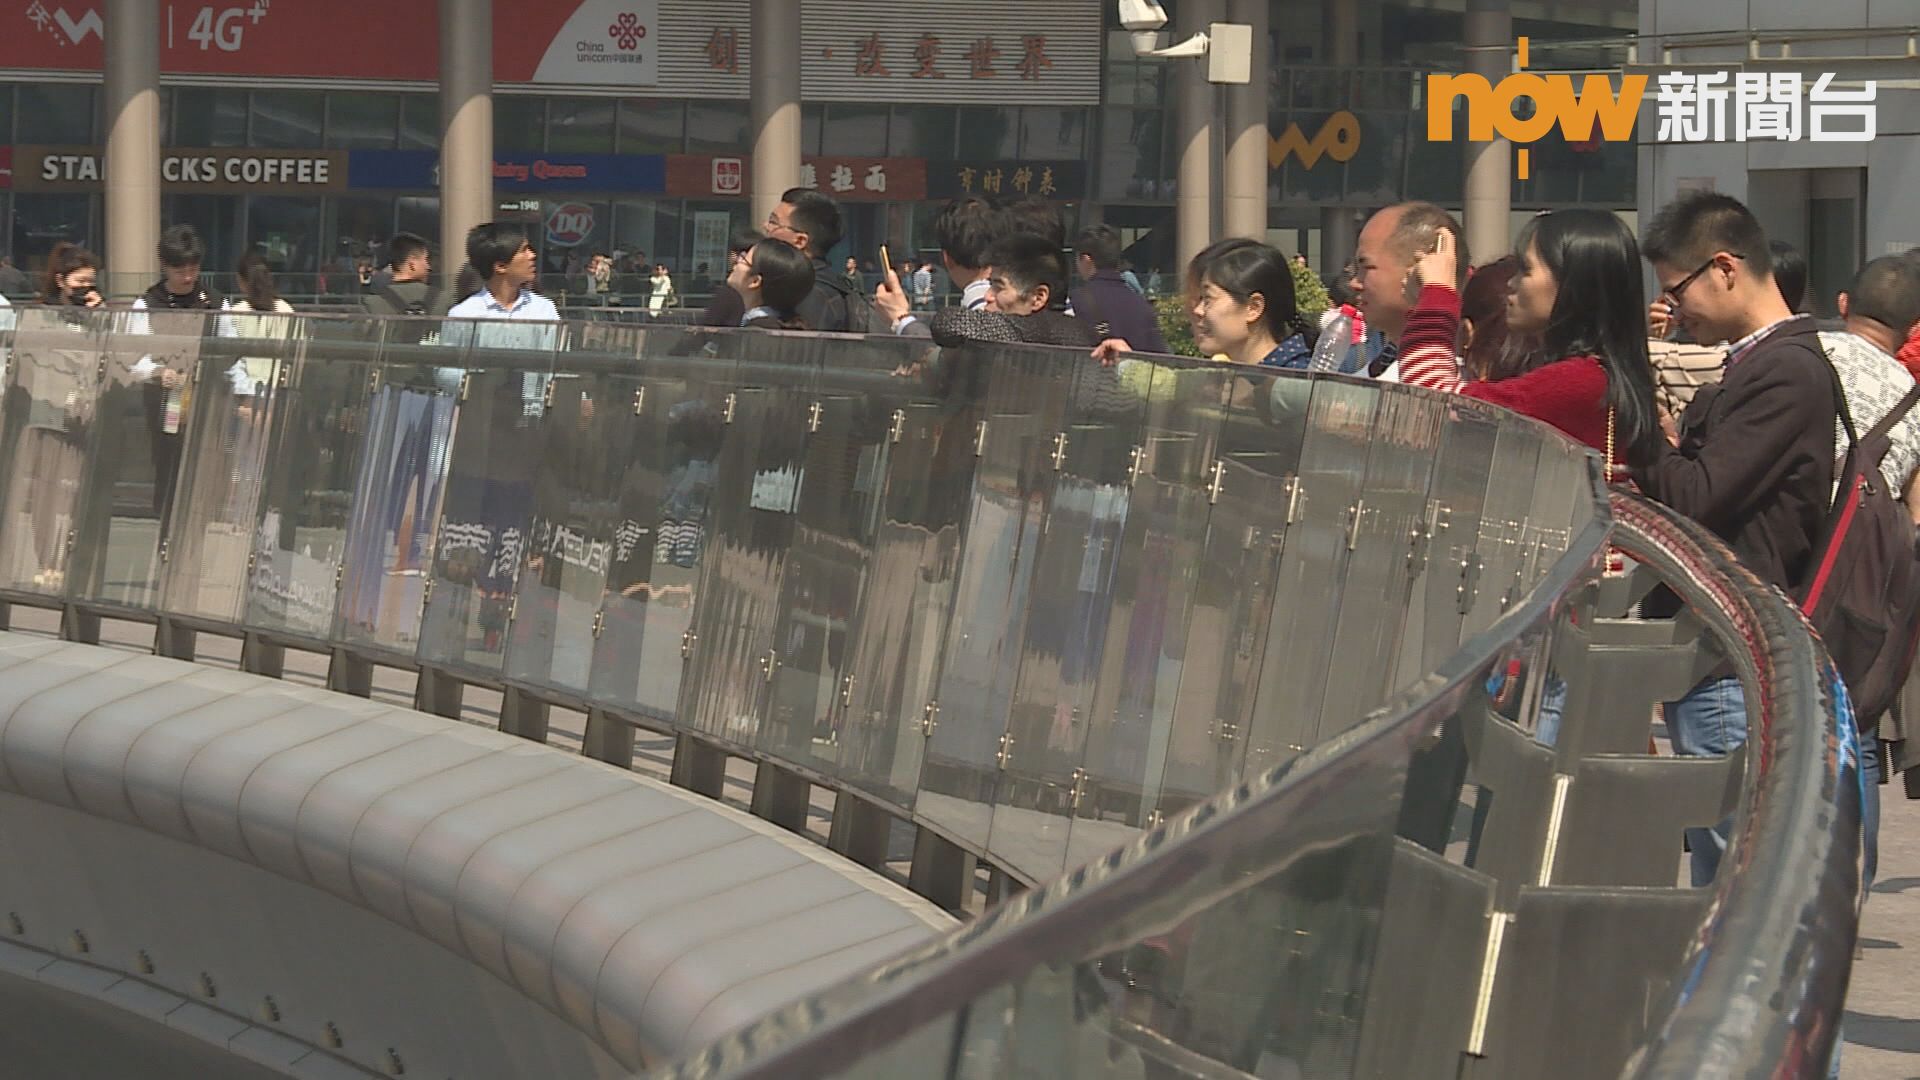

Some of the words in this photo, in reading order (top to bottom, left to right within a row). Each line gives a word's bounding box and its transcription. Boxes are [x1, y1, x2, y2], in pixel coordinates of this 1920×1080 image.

[576, 40, 604, 52] China
[42, 155, 217, 183] STACKS
[224, 158, 329, 184] COFFEE
[492, 160, 529, 182] airy
[533, 159, 587, 180] Queen
[519, 200, 540, 211] 1940
[556, 212, 590, 235] DQ
